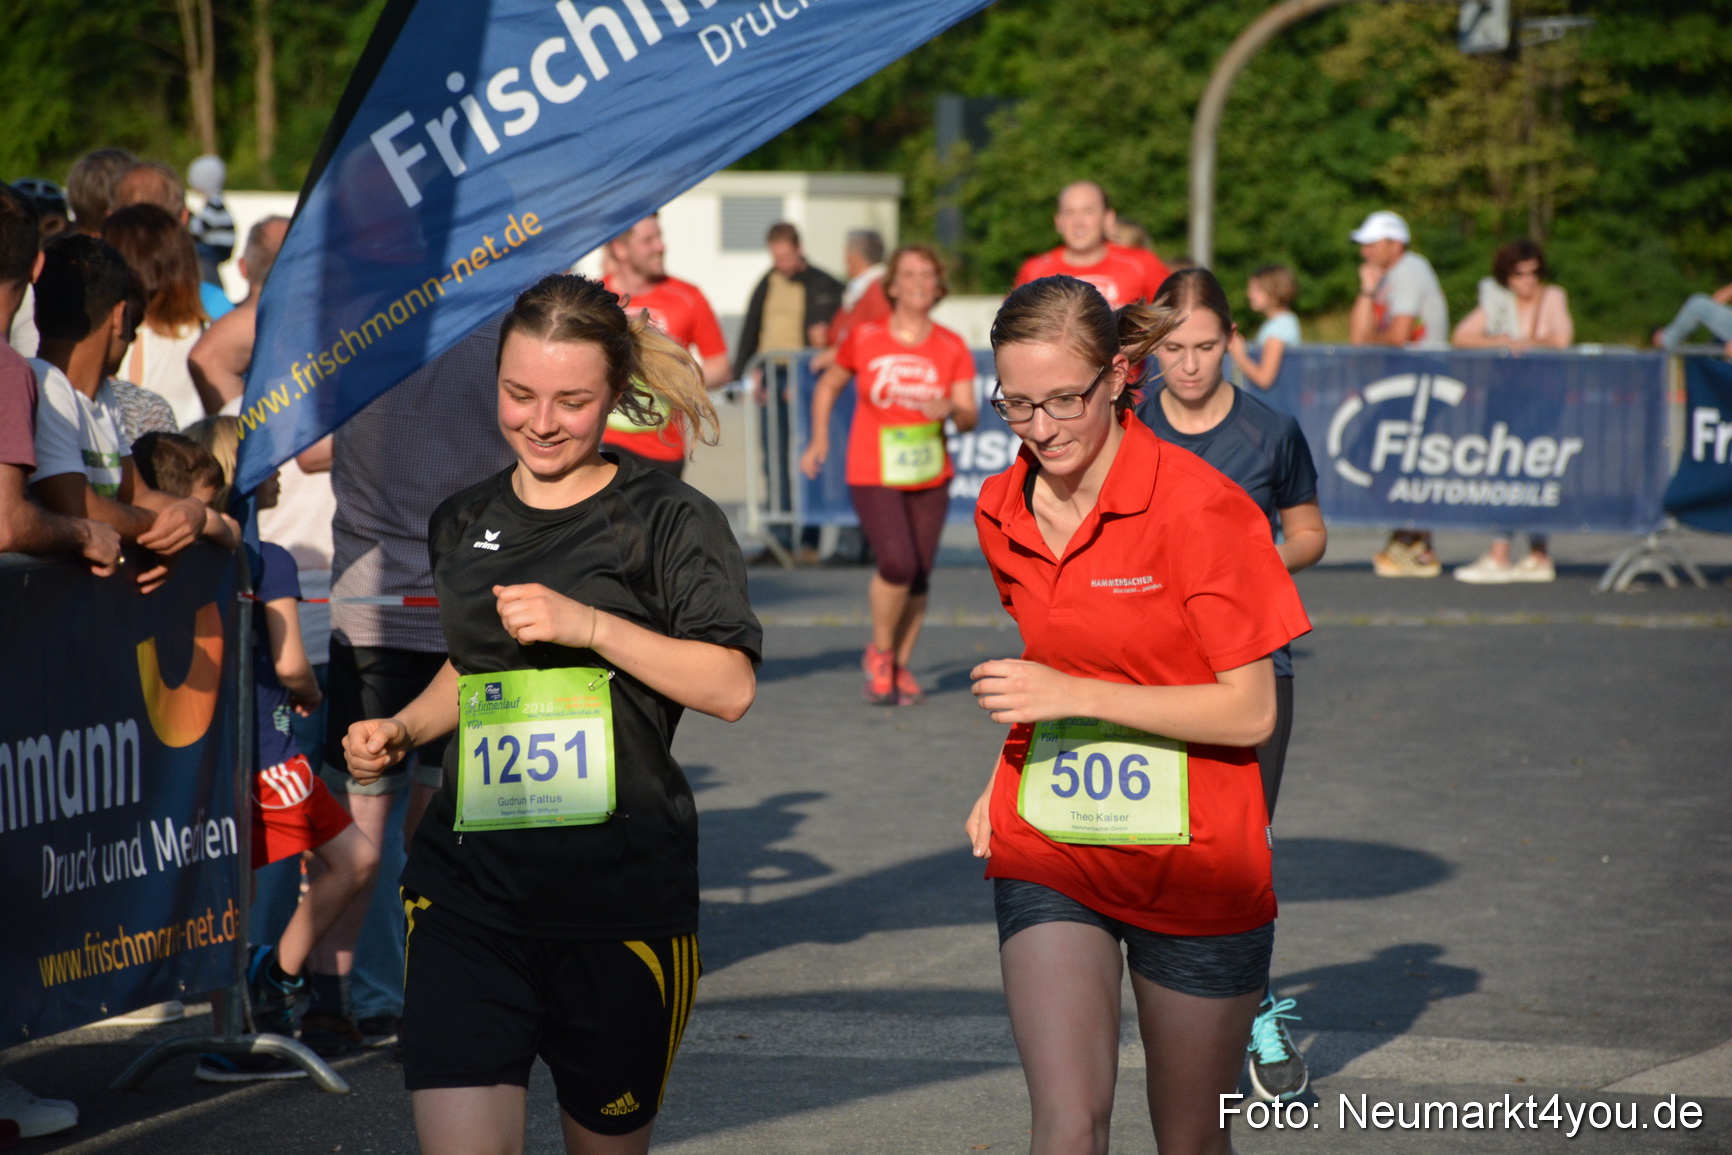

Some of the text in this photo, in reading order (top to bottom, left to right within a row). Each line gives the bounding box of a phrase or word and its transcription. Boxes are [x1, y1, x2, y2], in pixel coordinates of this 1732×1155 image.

[697, 0, 820, 66] Druc
[1371, 419, 1584, 478] Fischer
[1693, 406, 1732, 464] Fr
[1388, 478, 1562, 507] AUTOMOBILE
[1091, 576, 1153, 587] HAMMERBACHER
[522, 702, 554, 714] 2016
[474, 730, 588, 786] 1251
[1051, 751, 1150, 800] 506
[497, 794, 562, 807] Gudrun Faltus
[1071, 811, 1129, 822] Theo Kaiser
[42, 808, 238, 899] Druck und Medien
[600, 1102, 640, 1116] adidas
